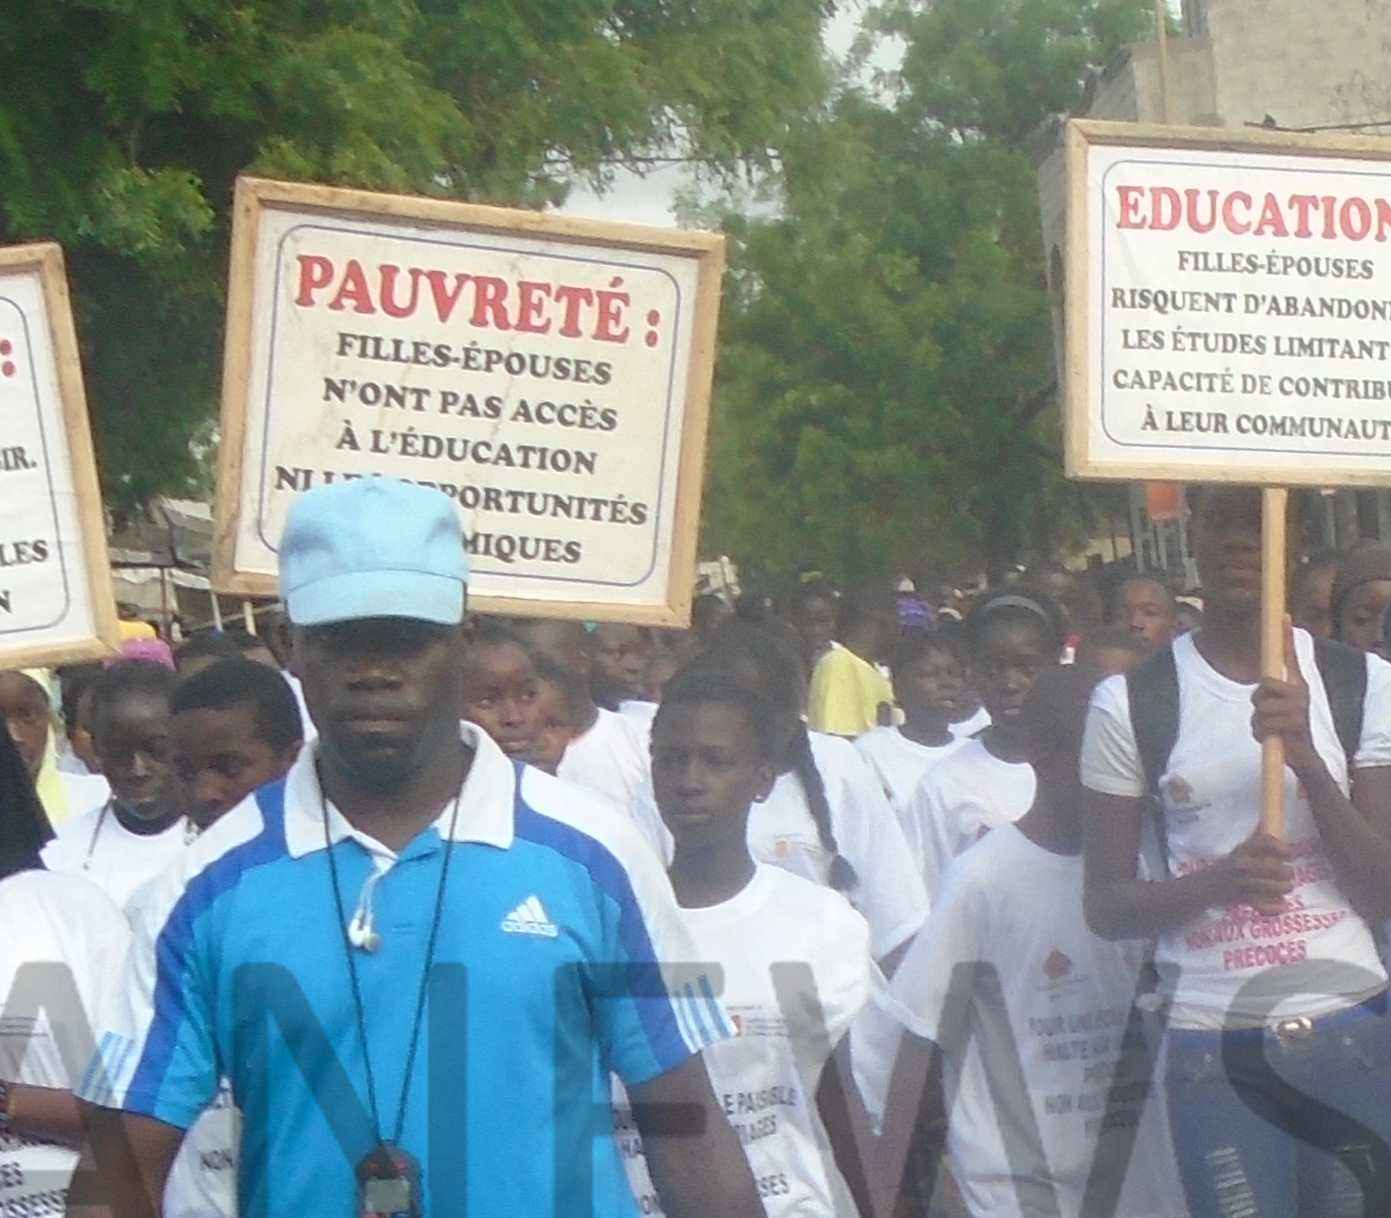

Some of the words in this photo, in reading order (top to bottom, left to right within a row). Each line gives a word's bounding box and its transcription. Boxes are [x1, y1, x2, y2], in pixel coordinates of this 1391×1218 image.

[1177, 249, 1374, 280] FILLES-ÉPOUSES
[294, 253, 631, 344] PAUVRETÉ
[1111, 287, 1237, 315] RISQUENT
[337, 331, 612, 386] FILLES-ÉPOUSES
[1121, 329, 1165, 351] LES
[1171, 325, 1267, 356] ÉTUDES
[1273, 335, 1390, 362] LIMITANT
[1112, 366, 1233, 393] CAPACITÉ
[1241, 374, 1272, 396] DE
[322, 375, 430, 413] N'ONT
[439, 390, 502, 420] PAS
[510, 397, 618, 432] ACCÈS
[1140, 403, 1160, 432] À
[1165, 410, 1228, 434] LEUR
[335, 418, 360, 452] À
[369, 426, 598, 475] L'ÉDUCATION
